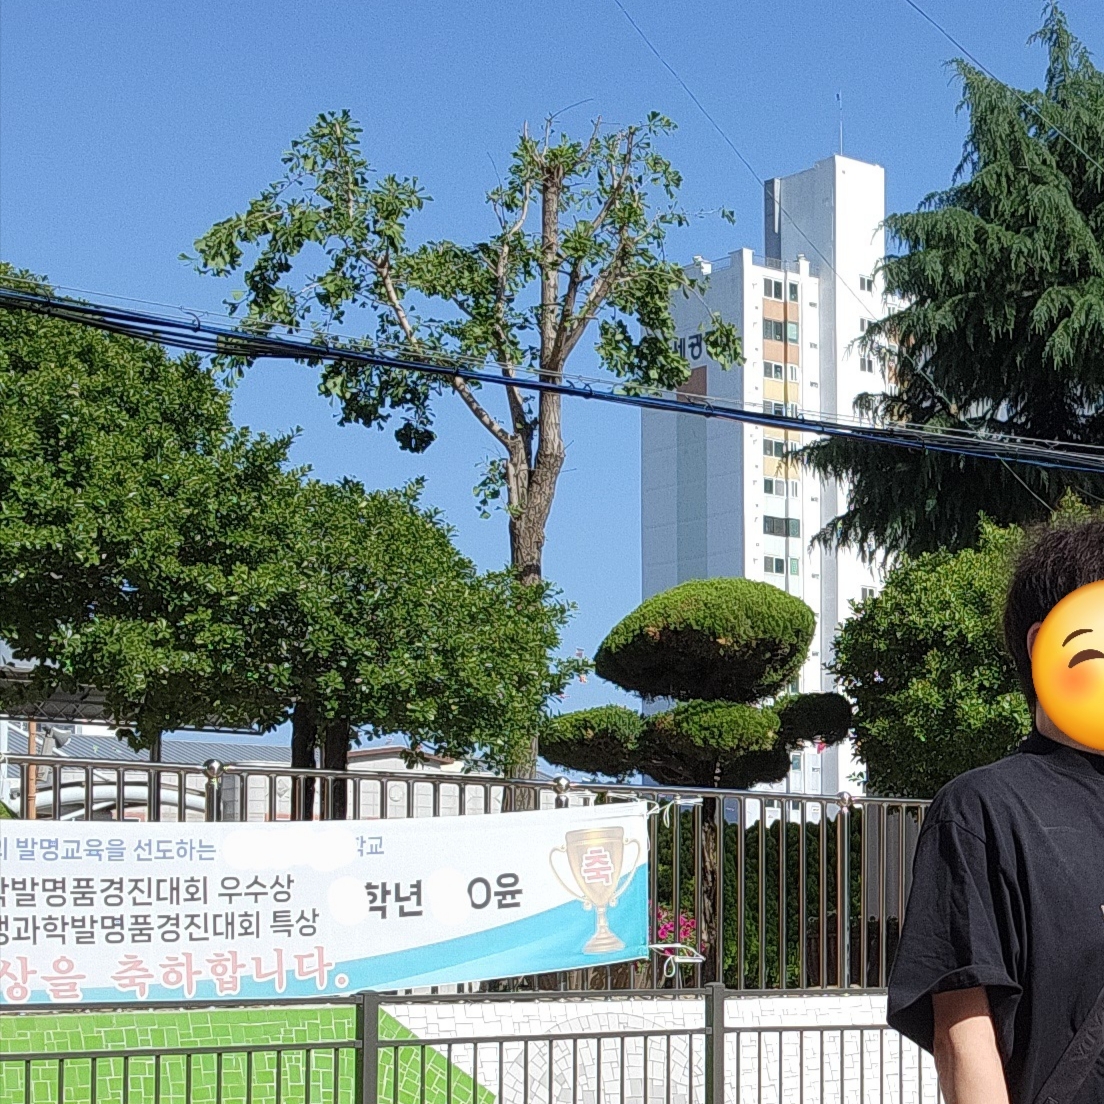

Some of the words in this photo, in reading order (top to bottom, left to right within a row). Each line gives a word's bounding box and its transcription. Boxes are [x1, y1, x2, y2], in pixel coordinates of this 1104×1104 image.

[16, 837, 126, 862] 발명교육을
[134, 838, 216, 862] 선도하는
[583, 848, 613, 885] 축
[218, 873, 295, 905] 우수상
[364, 878, 423, 919] 학년
[270, 907, 319, 938] 특상
[110, 945, 347, 998] 축하합니다.
